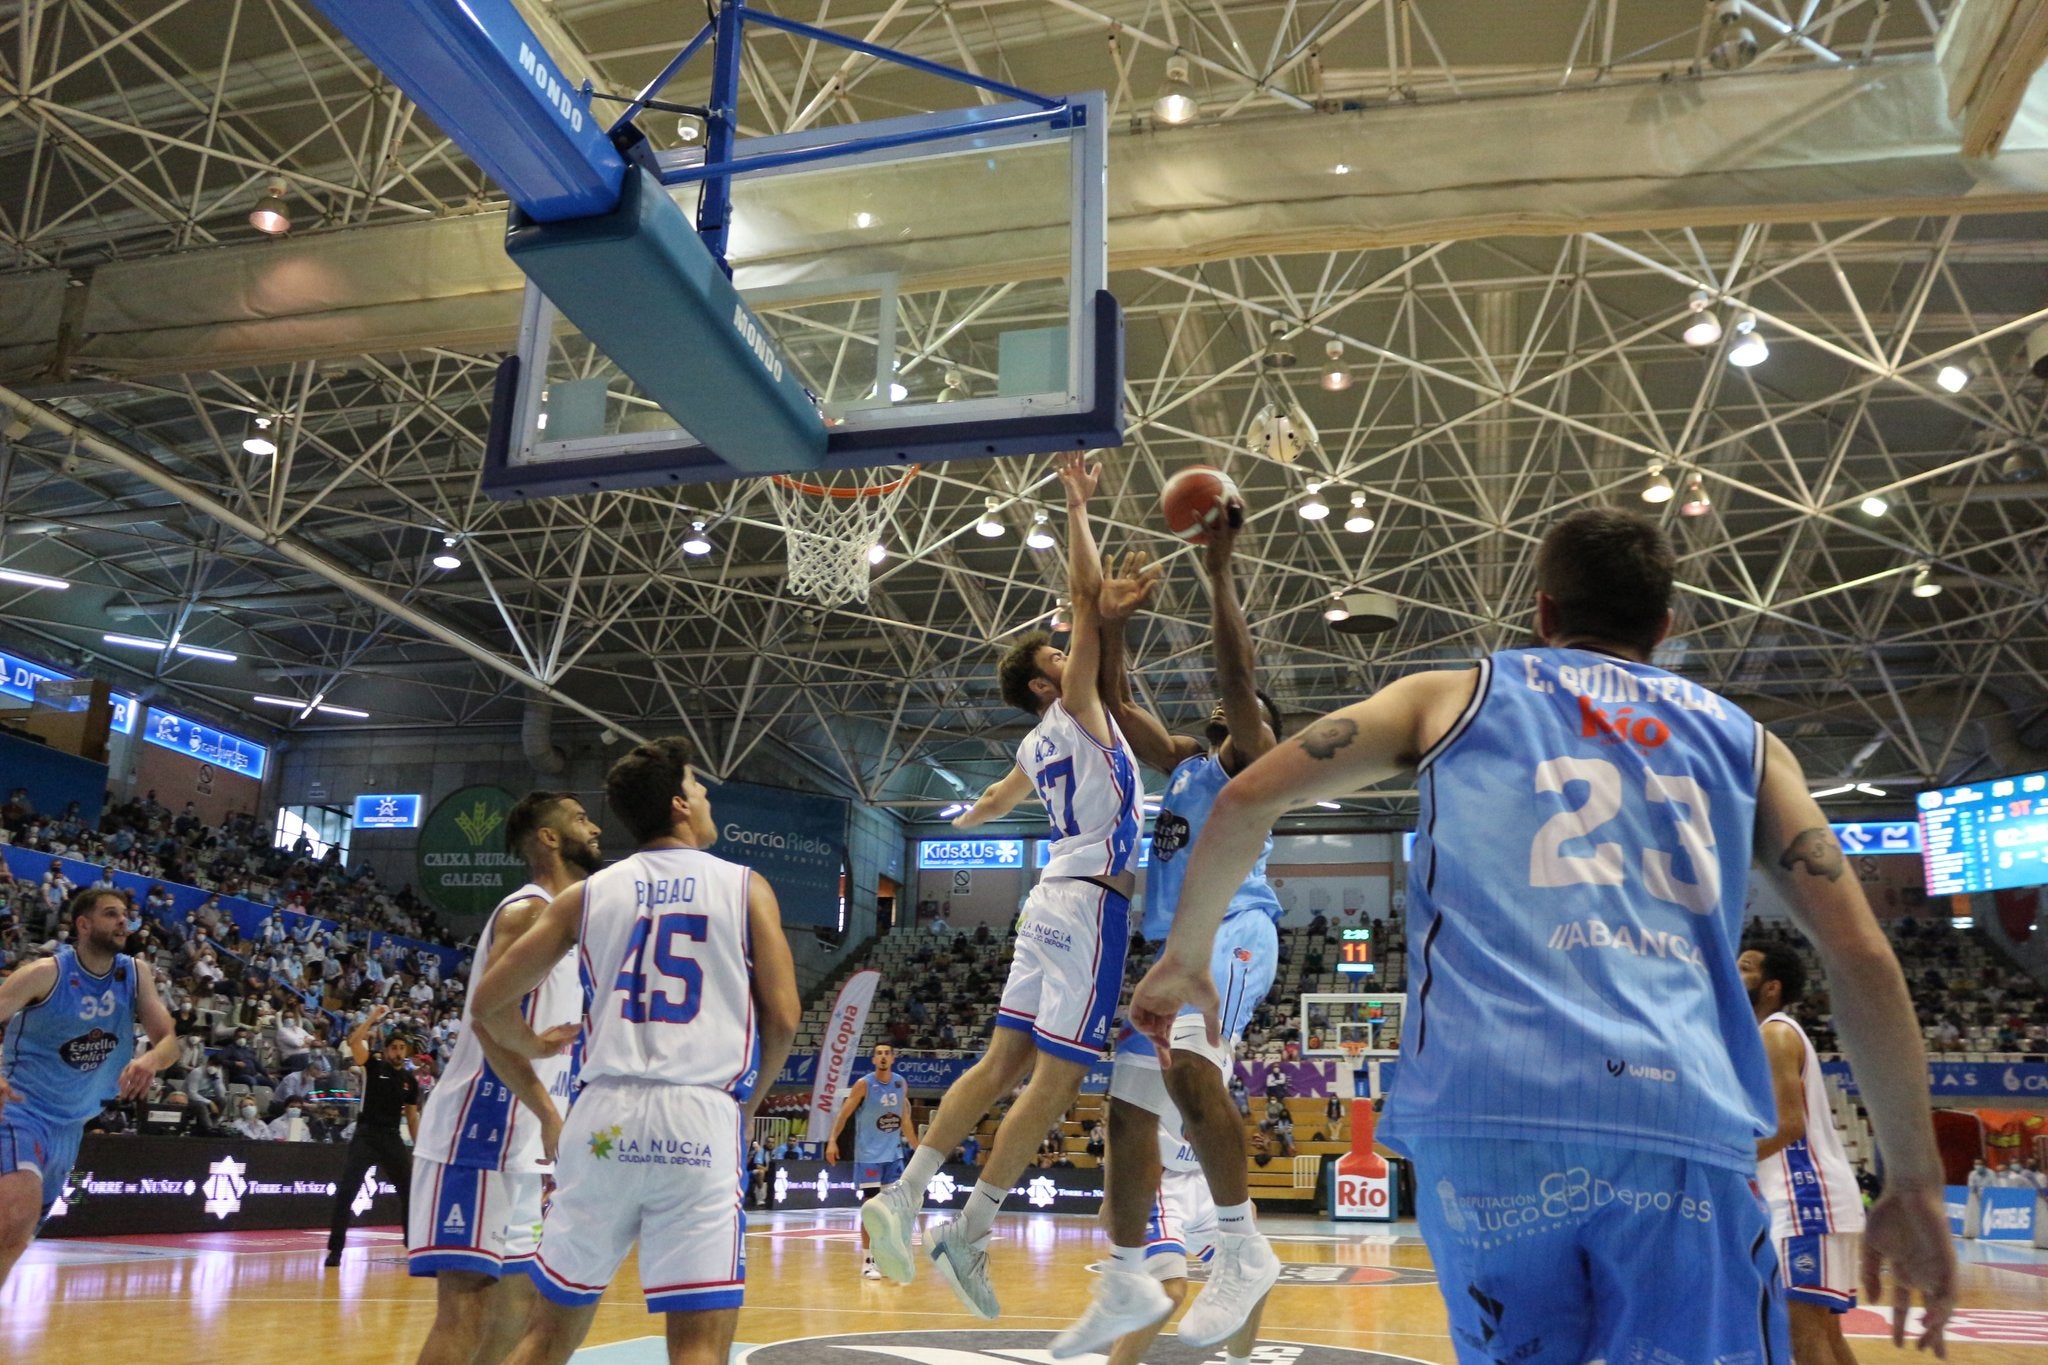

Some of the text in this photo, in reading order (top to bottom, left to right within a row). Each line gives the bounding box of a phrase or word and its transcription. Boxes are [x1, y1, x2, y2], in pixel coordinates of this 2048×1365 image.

[518, 42, 584, 133] MONDO
[733, 303, 782, 383] MONDO
[1529, 756, 1722, 916] 23
[424, 853, 471, 866] CAIXA
[924, 843, 994, 859] Kids&Us
[441, 874, 503, 887] GALEGA
[1342, 943, 1367, 962] 11
[615, 913, 708, 1024] 45
[79, 989, 117, 1021] 33
[69, 1039, 117, 1052] Estrella
[880, 1093, 898, 1107] 43
[619, 1139, 640, 1153] LA
[670, 1156, 712, 1169] DEPORTE
[1337, 1180, 1388, 1208] Río
